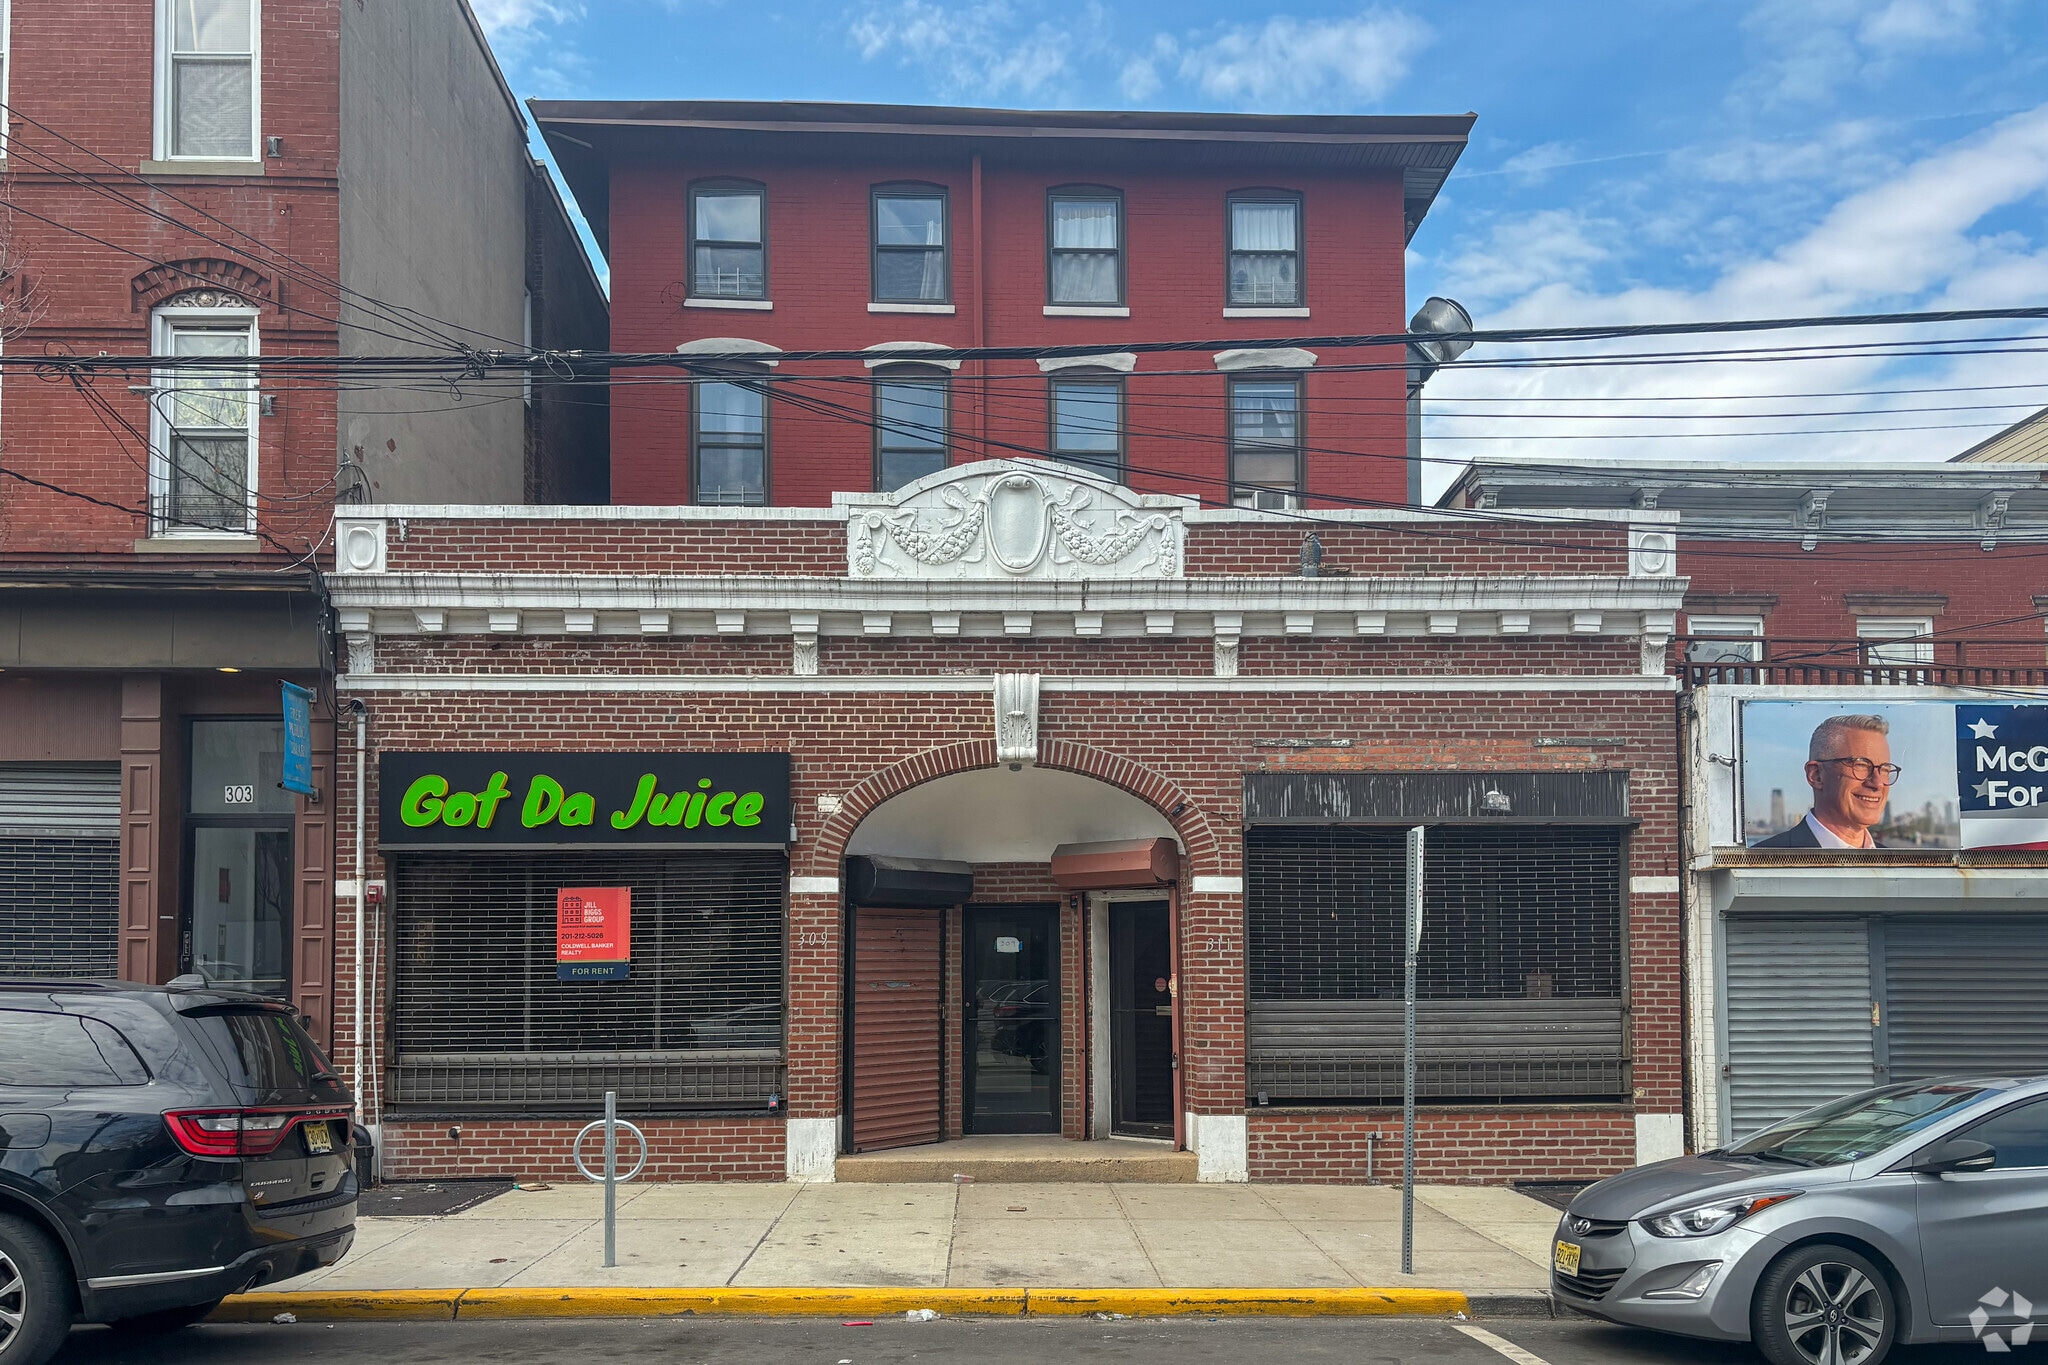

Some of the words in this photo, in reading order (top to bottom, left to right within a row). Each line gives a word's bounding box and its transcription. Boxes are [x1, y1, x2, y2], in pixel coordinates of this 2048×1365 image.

[226, 786, 252, 802] 303
[400, 771, 511, 829] Got
[520, 774, 595, 828] Da
[610, 773, 764, 829] Juice
[1987, 780, 2043, 807] For
[584, 901, 597, 909] JILL
[584, 908, 602, 916] BIGGS
[584, 915, 605, 923] GROUP
[798, 931, 828, 946] 309
[1207, 937, 1231, 952] 311
[591, 967, 615, 976] RENT
